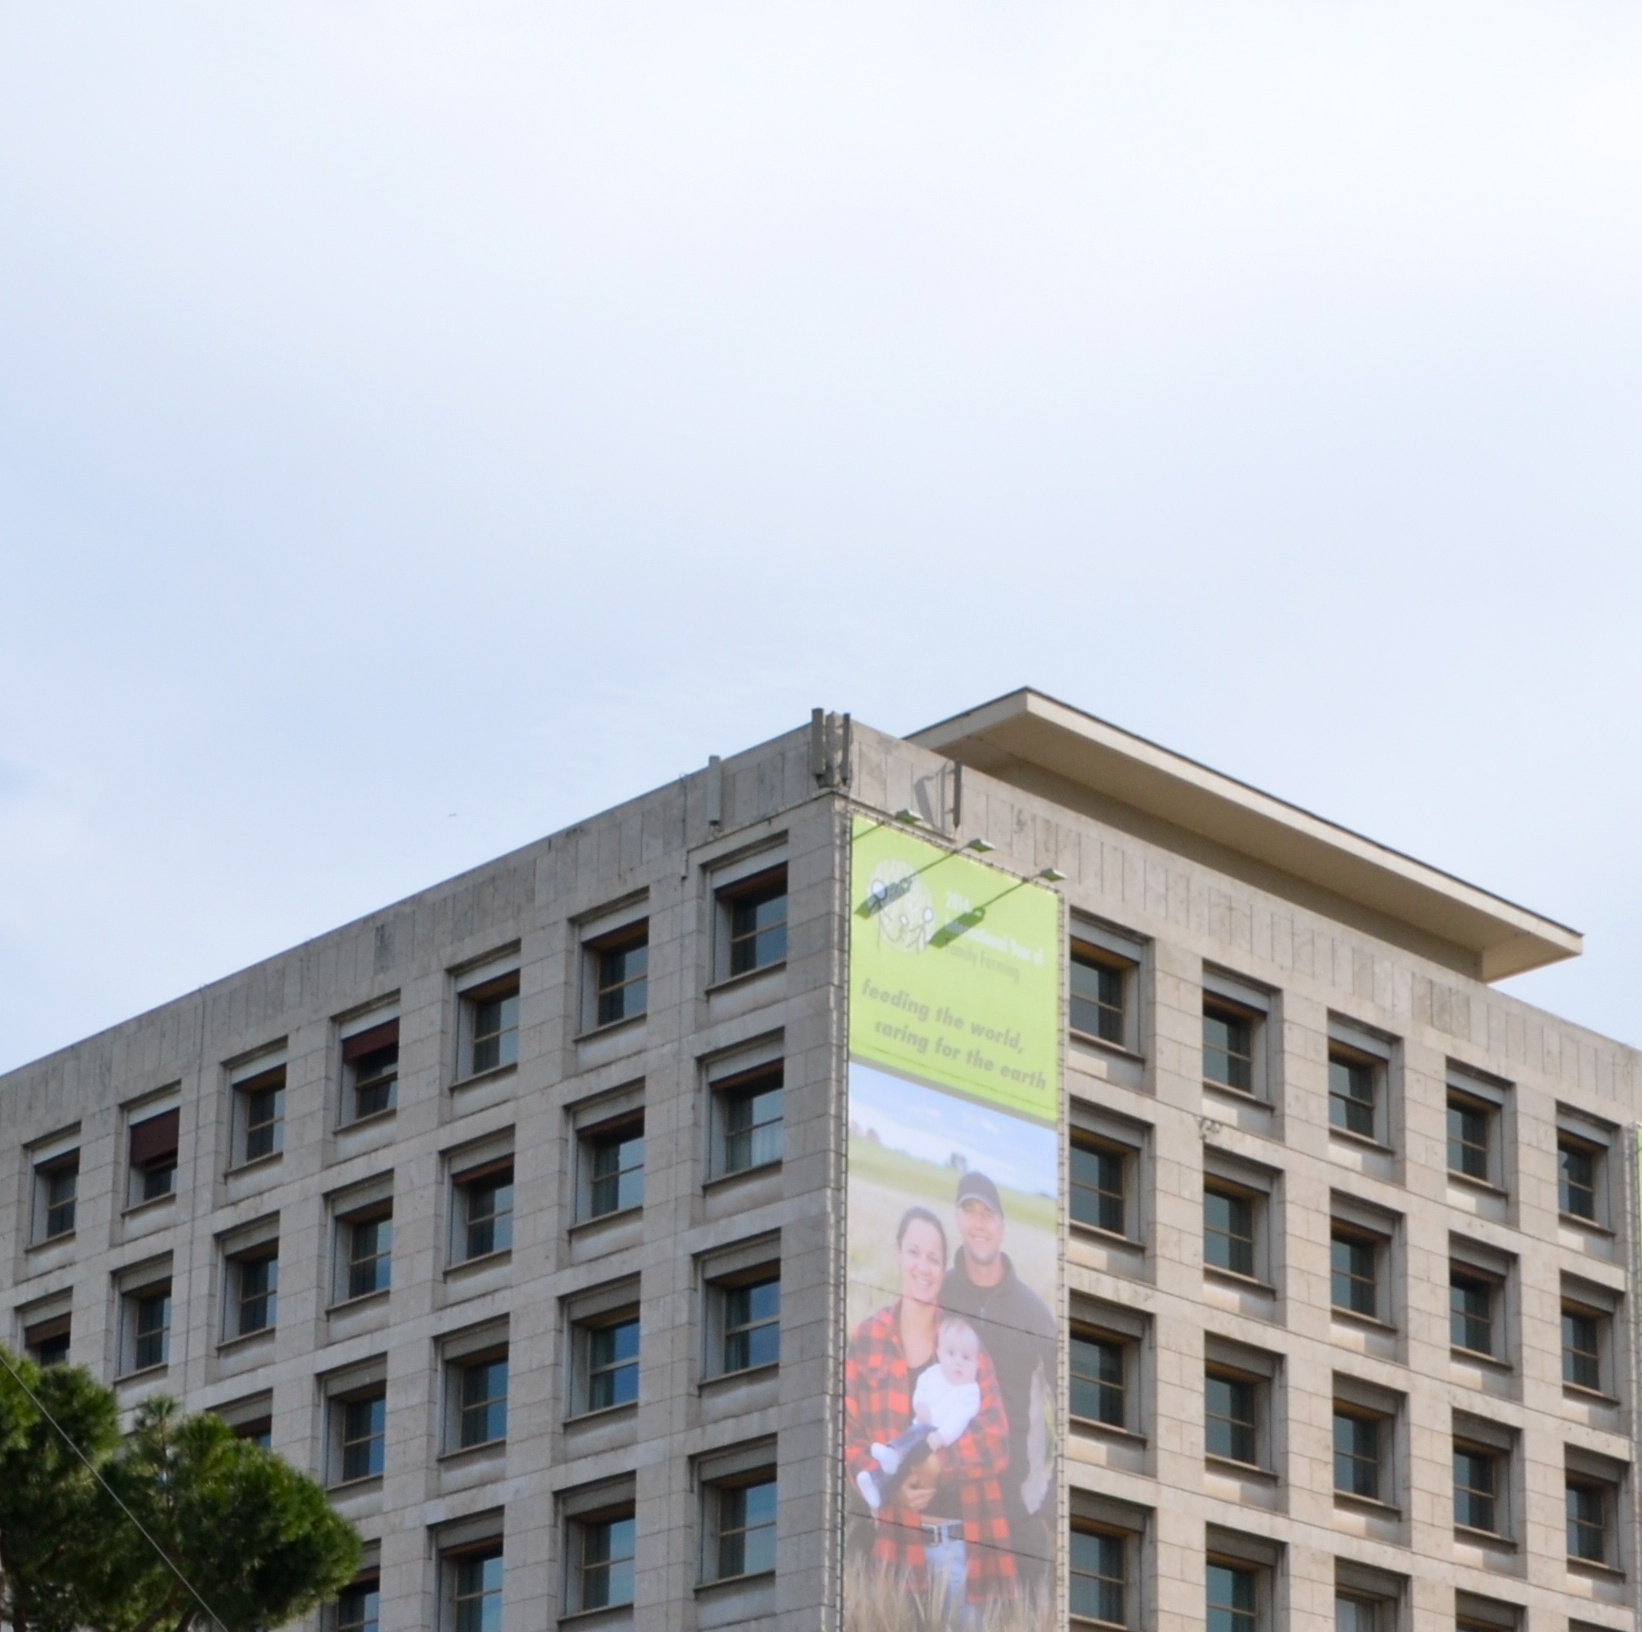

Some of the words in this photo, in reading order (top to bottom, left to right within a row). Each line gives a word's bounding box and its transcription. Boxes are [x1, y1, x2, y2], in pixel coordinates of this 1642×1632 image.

[862, 978, 930, 1022] feeding
[936, 1006, 964, 1029] the
[970, 1021, 1024, 1054] world,
[875, 1021, 929, 1054] caring
[935, 1036, 961, 1060] for
[966, 1048, 995, 1072] the
[999, 1065, 1047, 1091] earth
